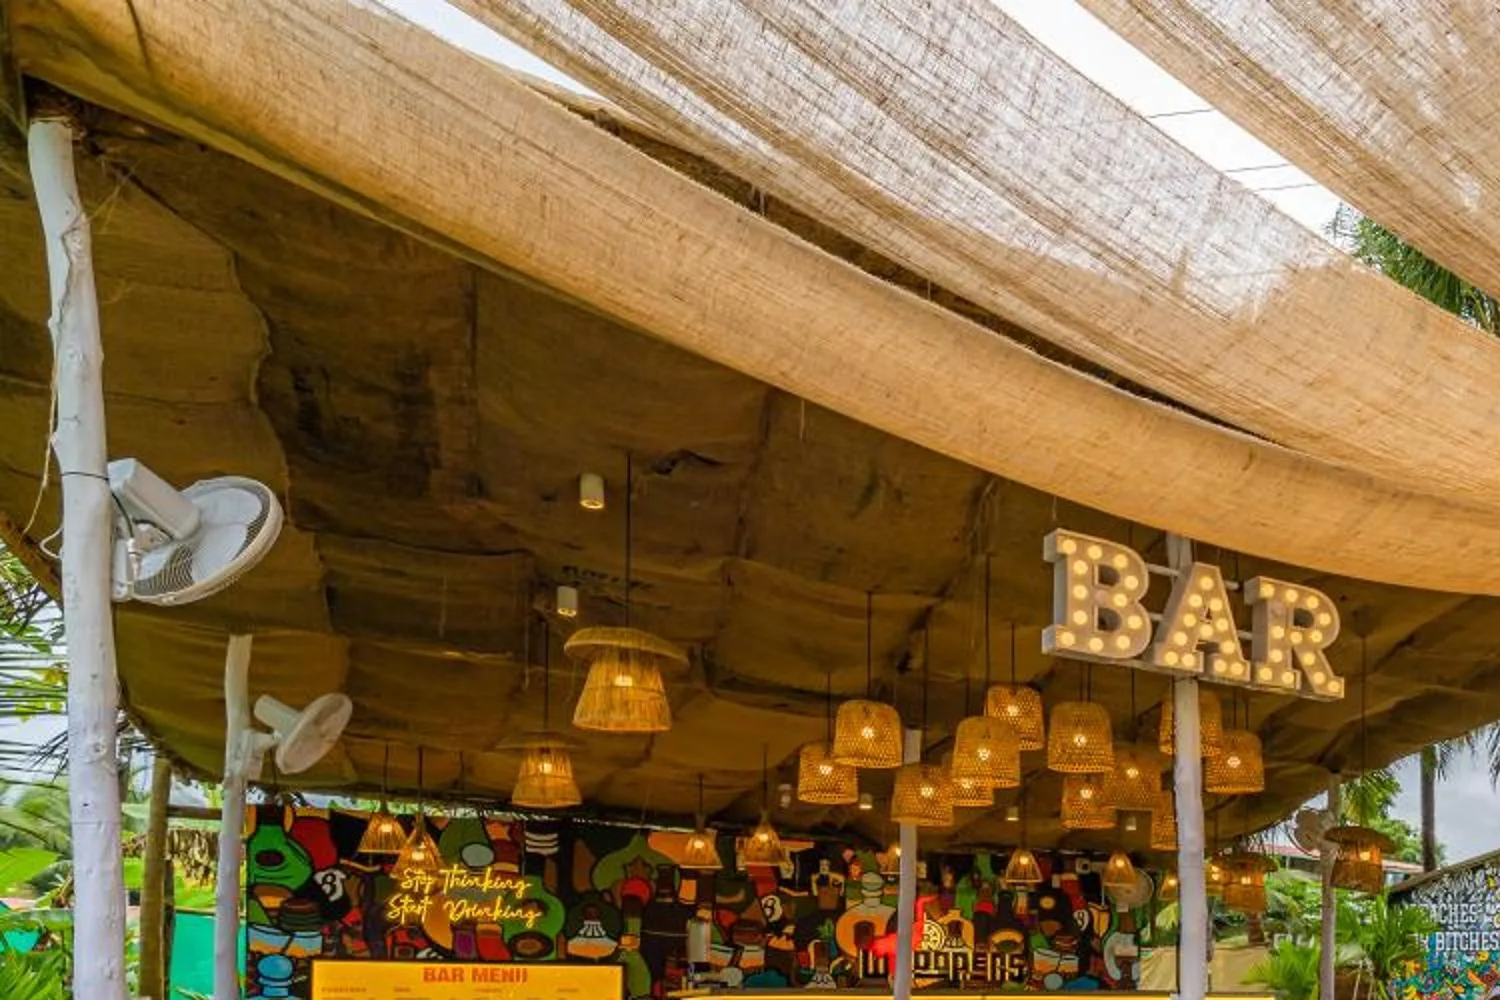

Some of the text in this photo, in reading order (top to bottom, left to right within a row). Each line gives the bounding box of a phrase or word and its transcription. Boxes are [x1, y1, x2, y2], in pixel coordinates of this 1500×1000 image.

[1042, 528, 1345, 698] BAR
[439, 864, 533, 898] Thinking
[387, 894, 543, 928] Start Drinking
[423, 967, 528, 983] BAR MENU
[860, 949, 1026, 981] WOOPERS
